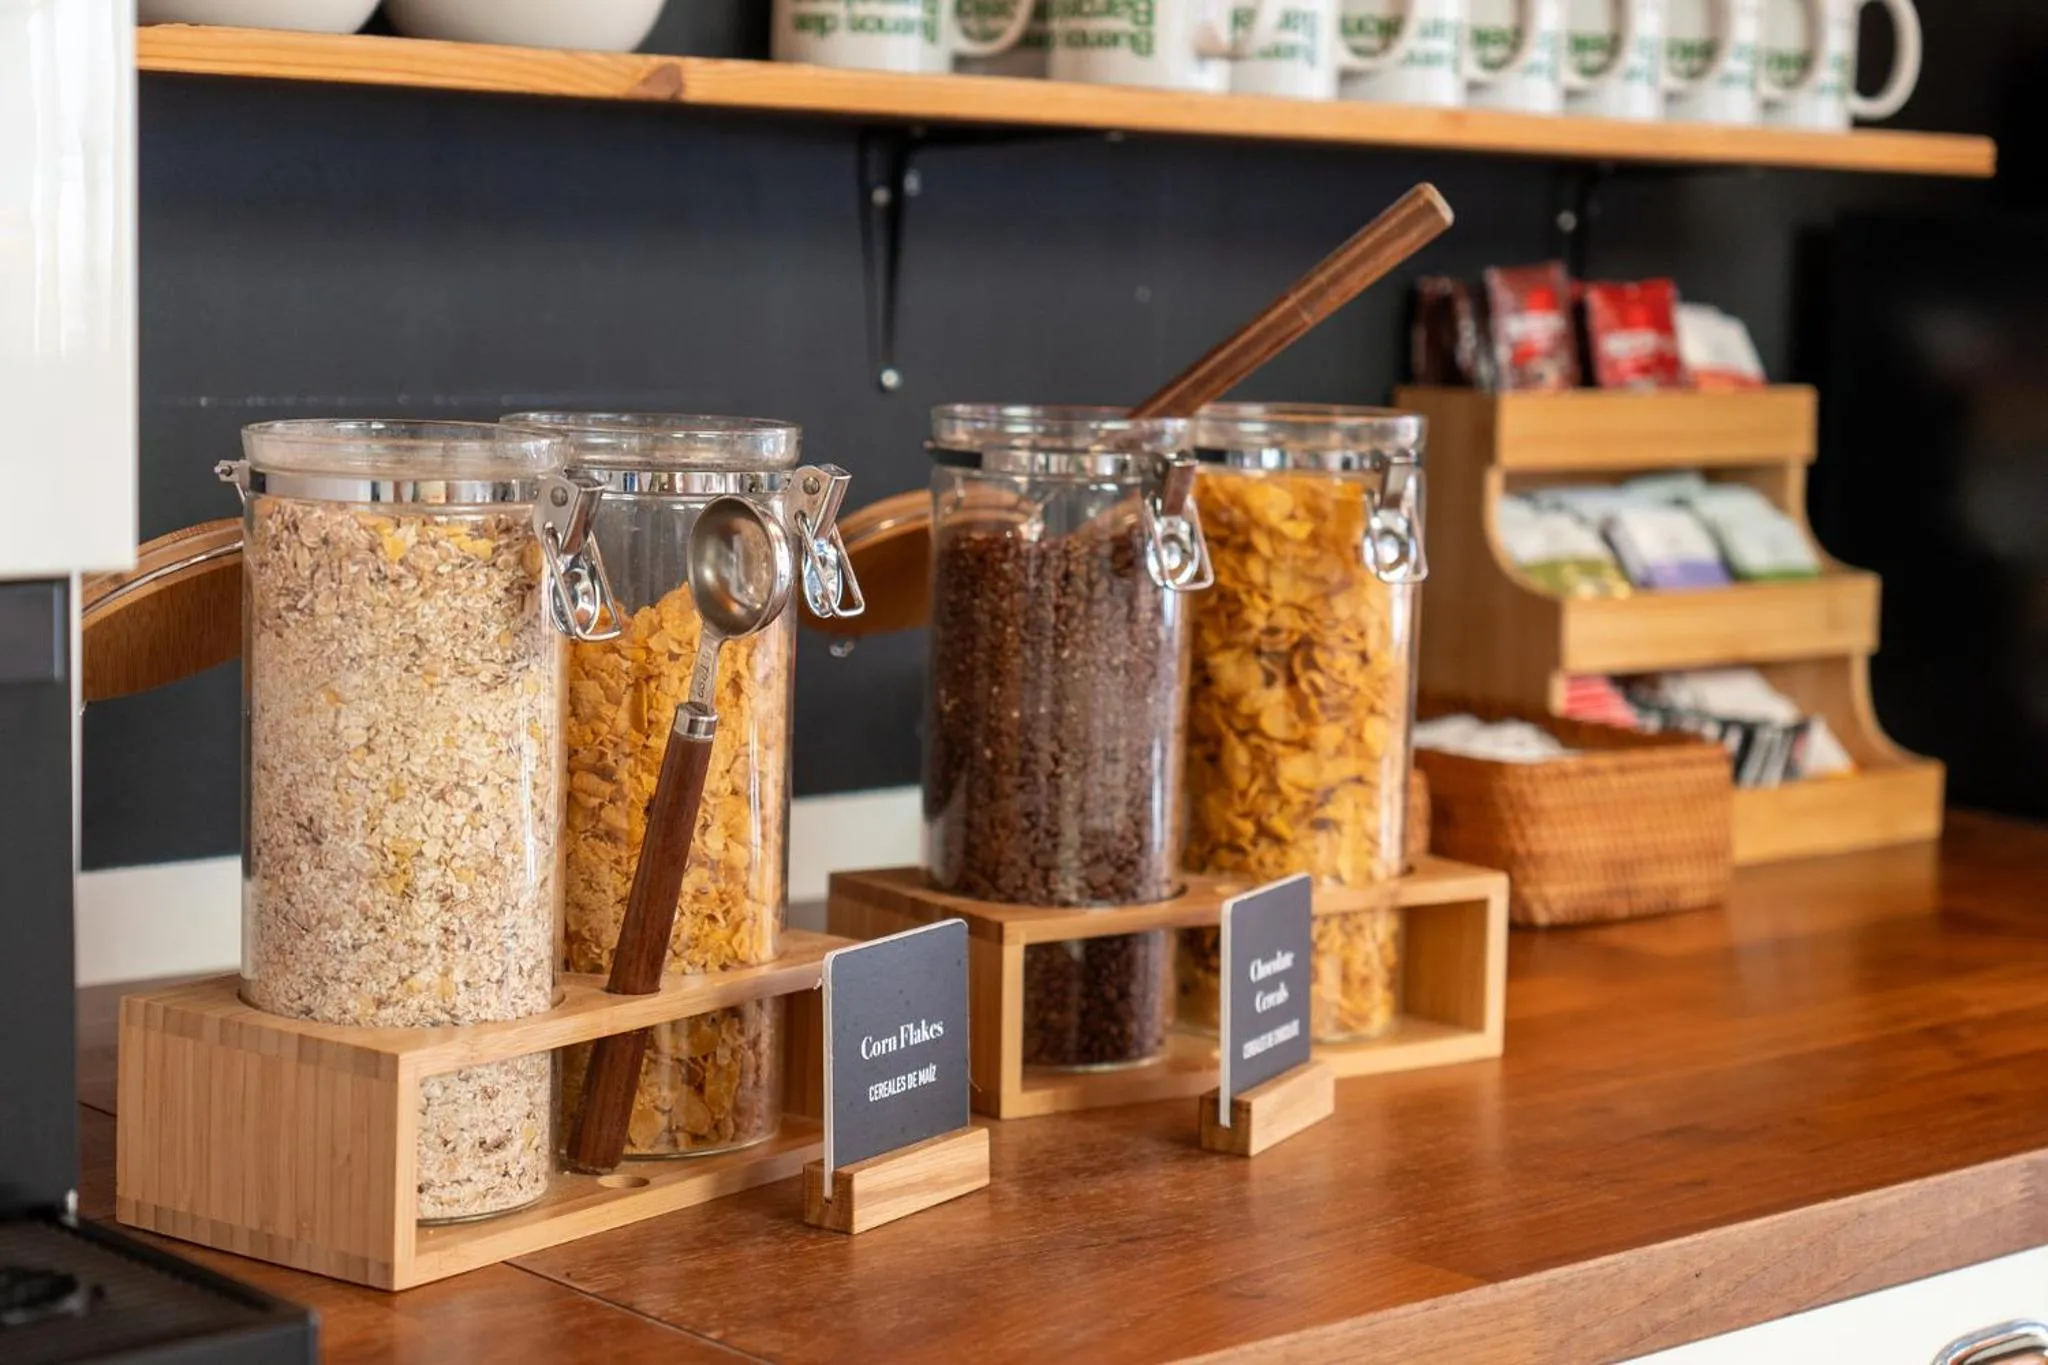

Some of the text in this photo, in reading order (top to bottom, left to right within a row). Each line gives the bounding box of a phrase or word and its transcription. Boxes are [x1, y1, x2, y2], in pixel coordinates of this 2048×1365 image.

[860, 1018, 944, 1061] Corn Flakes
[869, 1075, 906, 1103] CEREALES
[907, 1071, 919, 1090] DE
